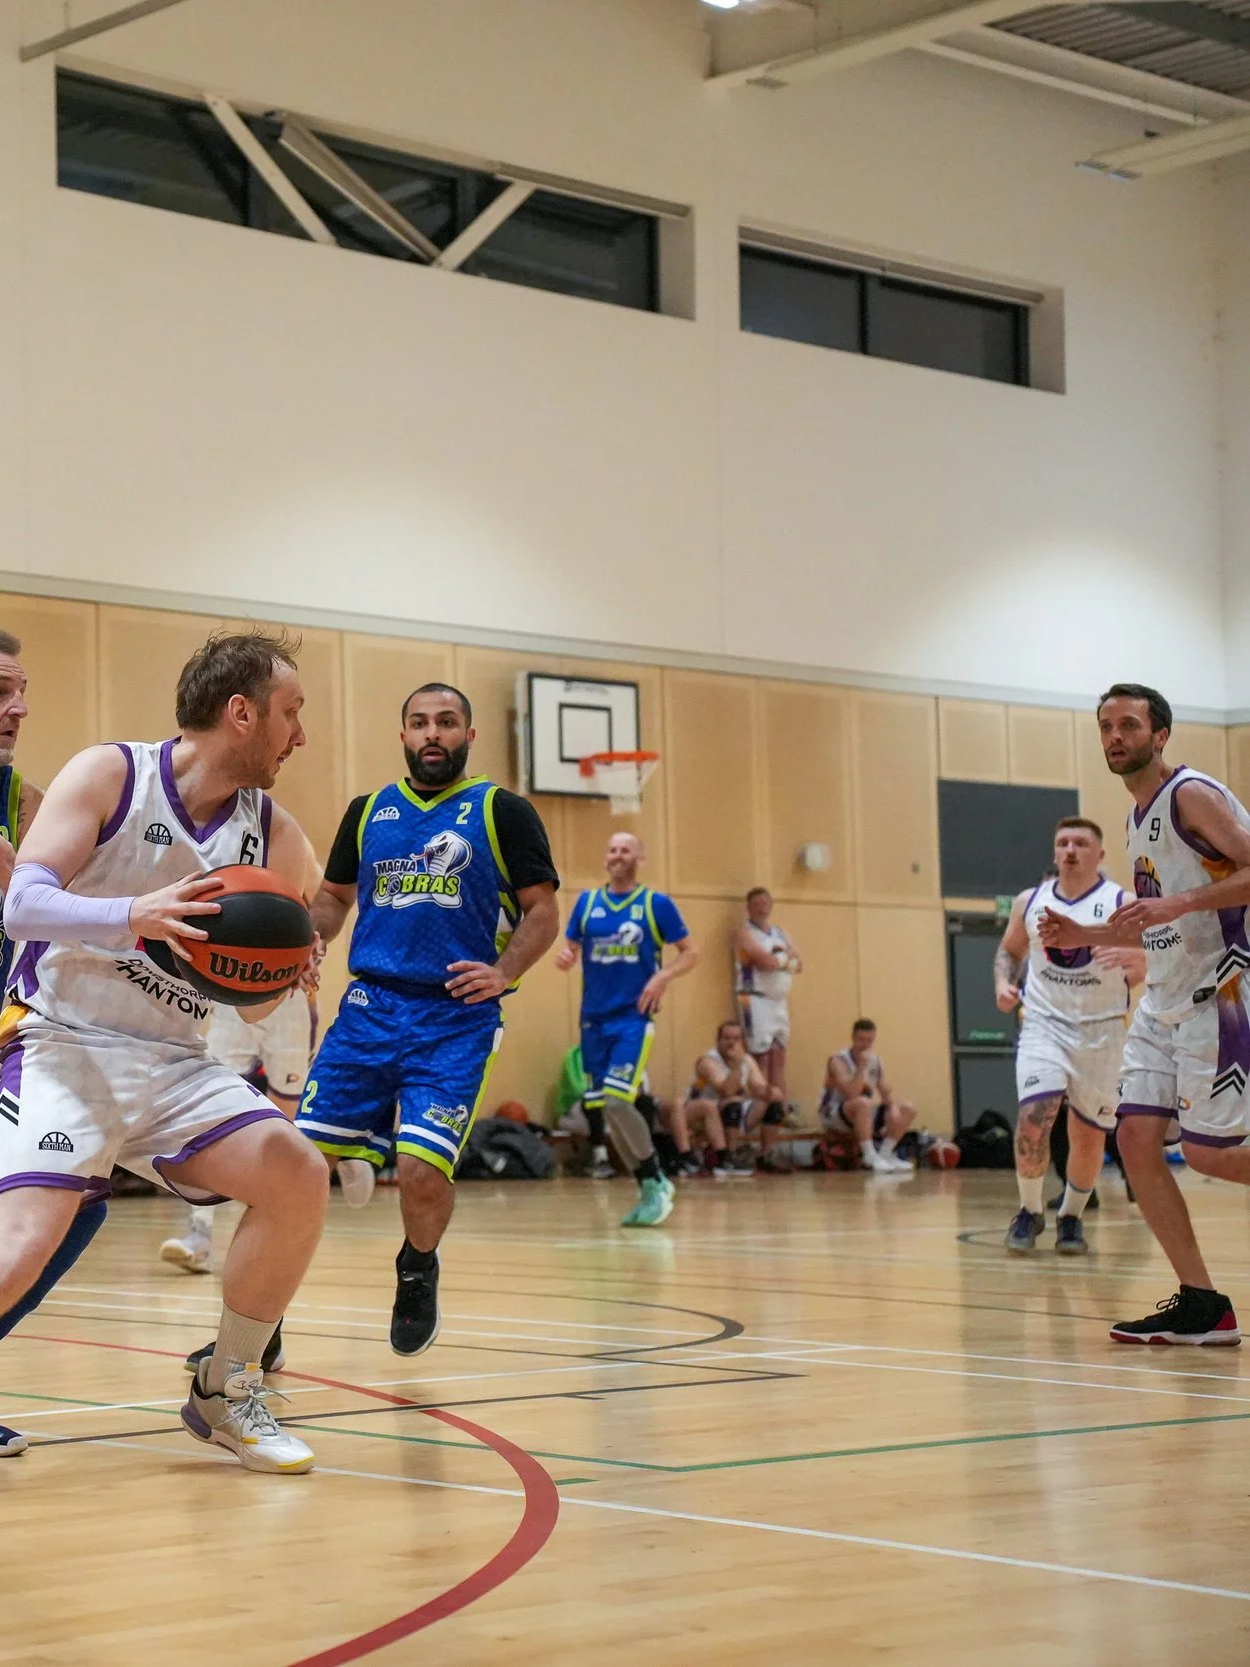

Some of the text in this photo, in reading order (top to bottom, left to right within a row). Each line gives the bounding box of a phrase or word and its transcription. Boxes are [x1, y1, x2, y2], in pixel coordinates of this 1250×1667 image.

[456, 802, 472, 825] 2
[1149, 818, 1161, 841] 9
[375, 860, 417, 875] MAGNA
[377, 874, 461, 897] COBRAS
[1094, 903, 1103, 918] 6
[210, 952, 299, 983] Wilson
[301, 1080, 319, 1114] 2
